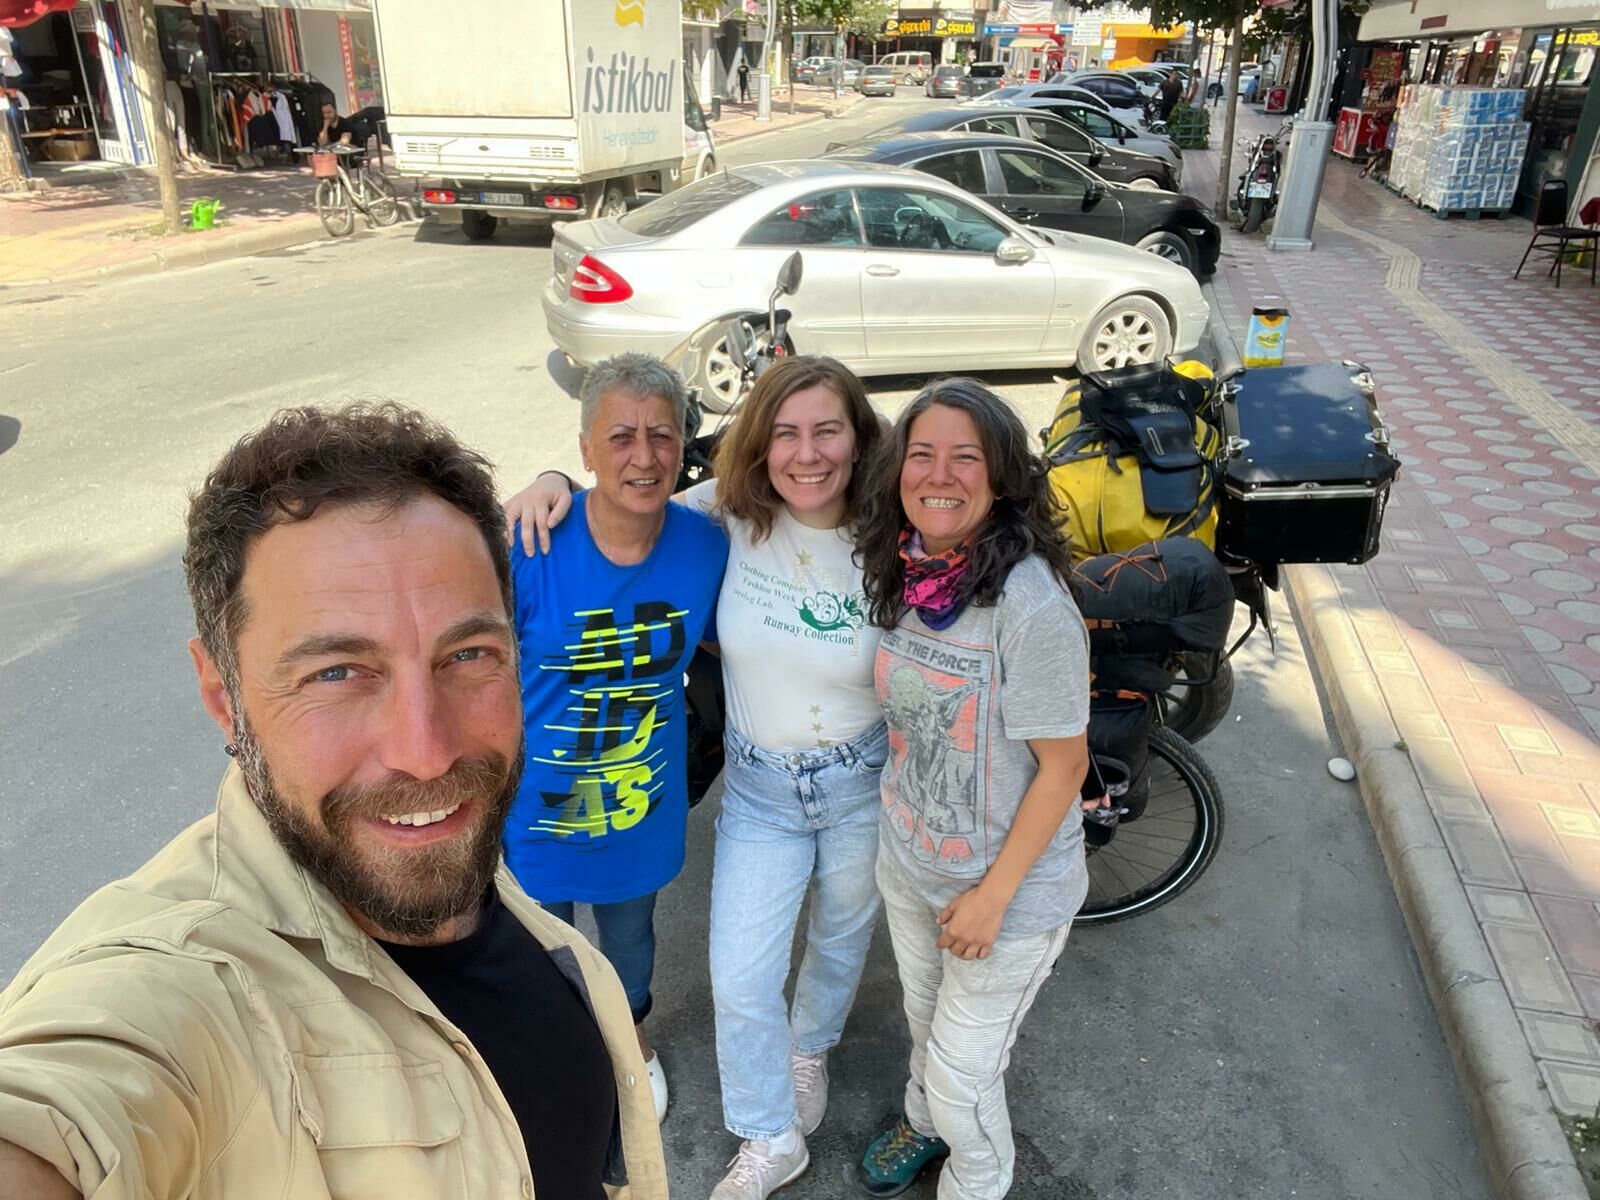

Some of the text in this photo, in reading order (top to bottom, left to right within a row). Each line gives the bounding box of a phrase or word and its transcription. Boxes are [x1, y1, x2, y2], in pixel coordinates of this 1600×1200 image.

[582, 46, 676, 114] istikbal
[739, 560, 770, 582] Clothing
[743, 576, 772, 594] Fashion
[763, 615, 801, 637] Runway
[804, 626, 854, 645] Collection
[905, 640, 929, 660] THE
[929, 648, 982, 673] FORCE
